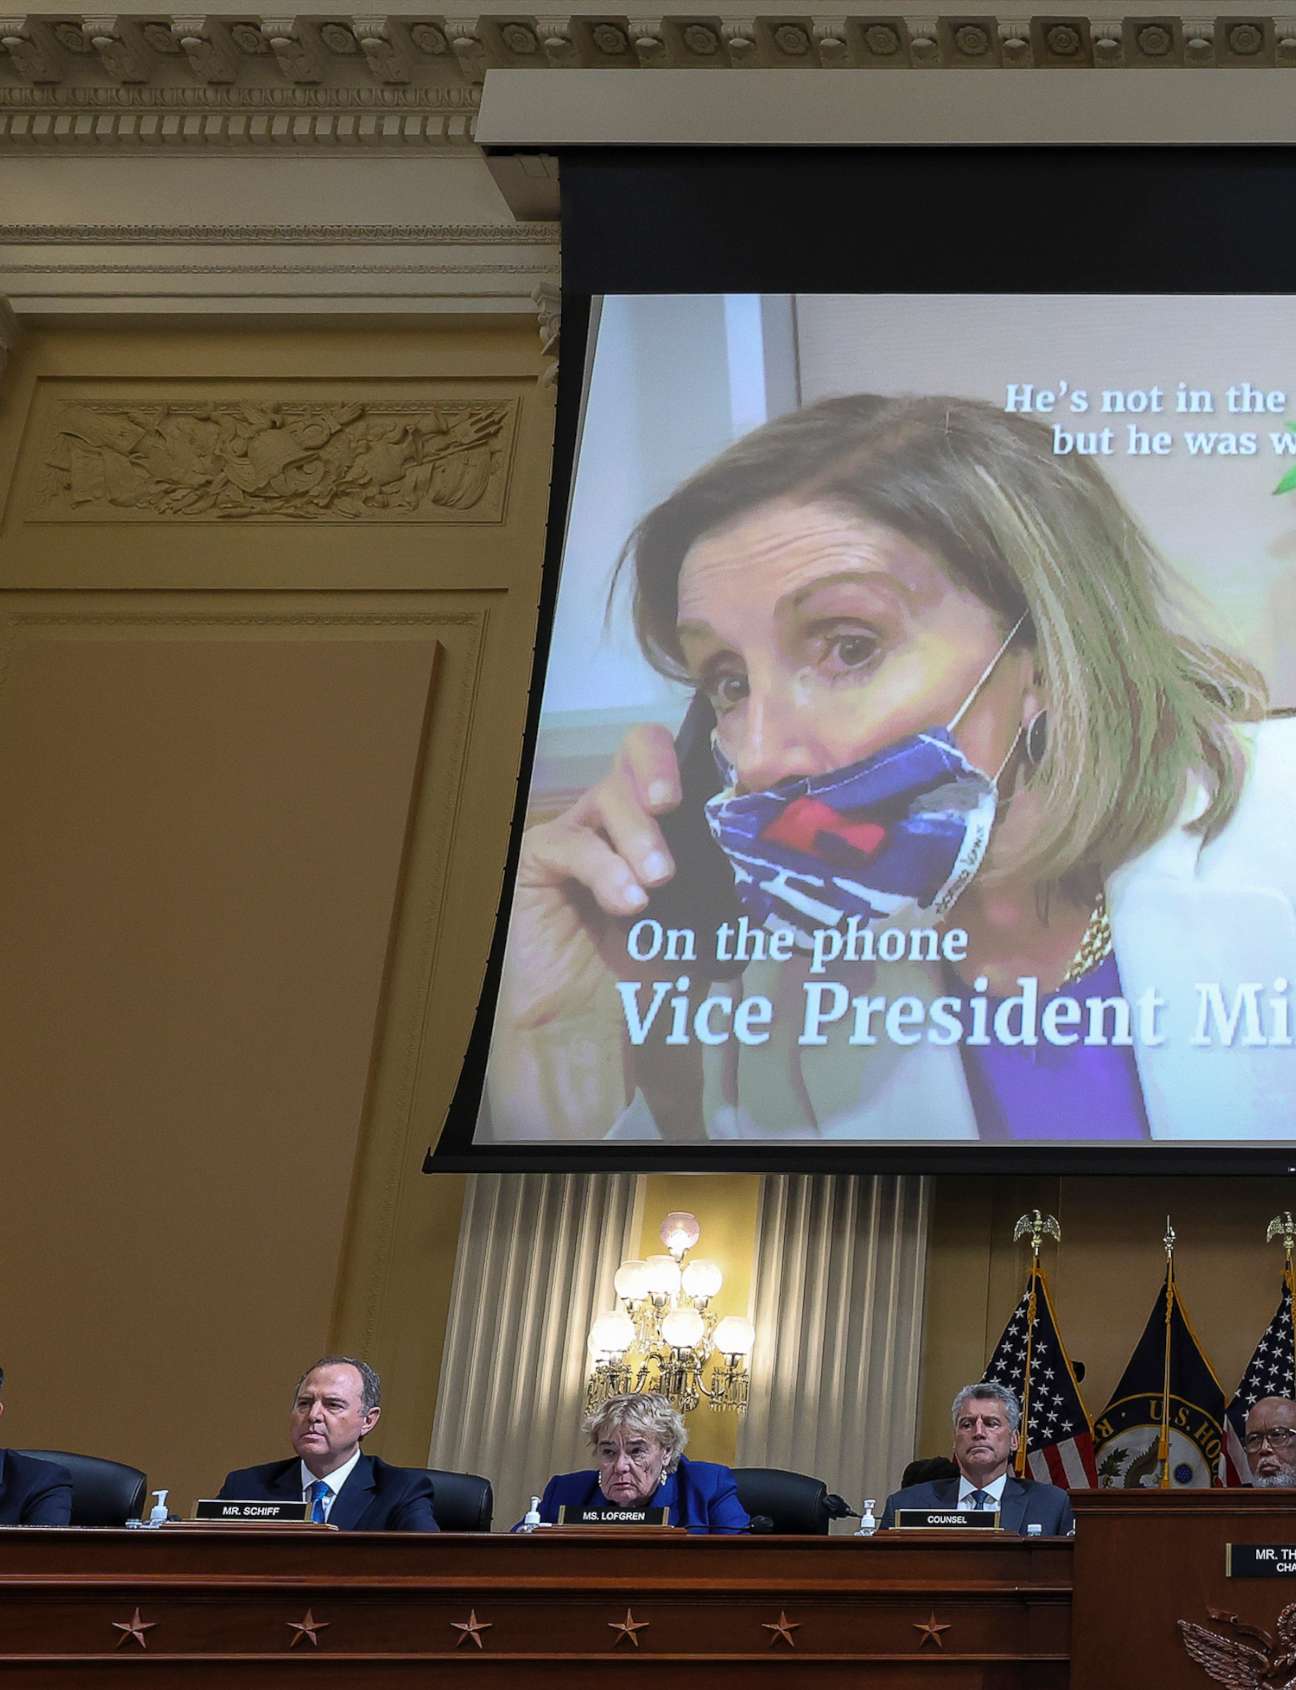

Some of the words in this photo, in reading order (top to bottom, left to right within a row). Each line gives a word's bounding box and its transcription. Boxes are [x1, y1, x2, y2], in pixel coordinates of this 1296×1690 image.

[1004, 383, 1088, 413] He’s
[1101, 388, 1162, 413] not
[1175, 382, 1214, 413] in
[1227, 383, 1285, 413] the
[1052, 425, 1113, 455] but
[1127, 426, 1172, 455] he
[1184, 434, 1257, 455] was
[626, 918, 696, 962] On
[715, 916, 794, 962] the
[810, 915, 969, 973] phone
[616, 975, 773, 1046] Vice
[797, 976, 1167, 1047] President
[222, 1506, 241, 1516] MR.
[243, 1506, 281, 1516] SCHIFF
[582, 1511, 600, 1521] MS.
[601, 1511, 646, 1521] LOFGREN
[927, 1515, 968, 1524] COUNSEL
[1255, 1549, 1279, 1560] MR.
